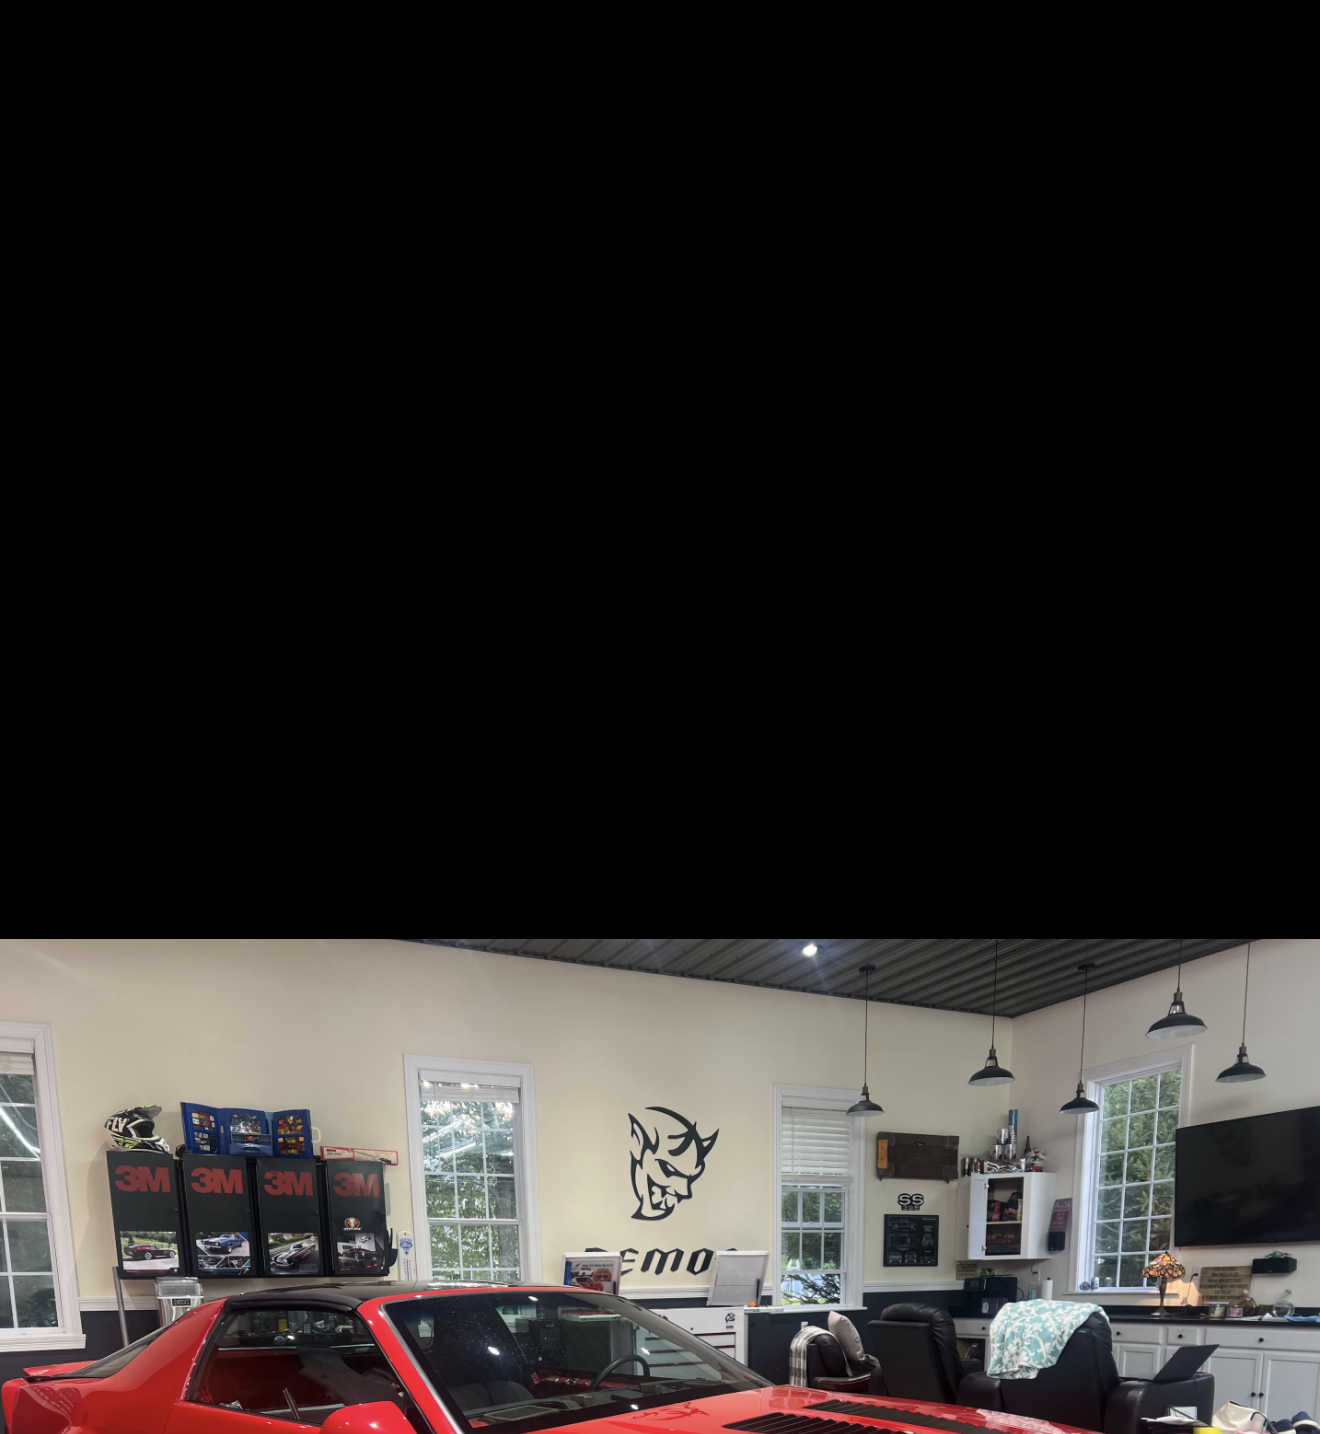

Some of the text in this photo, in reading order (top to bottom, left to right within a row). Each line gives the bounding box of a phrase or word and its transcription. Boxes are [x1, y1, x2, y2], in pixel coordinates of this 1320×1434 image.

[115, 1165, 171, 1193] 3M
[190, 1167, 243, 1194] 3M
[264, 1170, 314, 1196] 3M
[333, 1172, 380, 1197] 3M
[898, 1193, 924, 1206] SS
[585, 1247, 738, 1276] EMO
